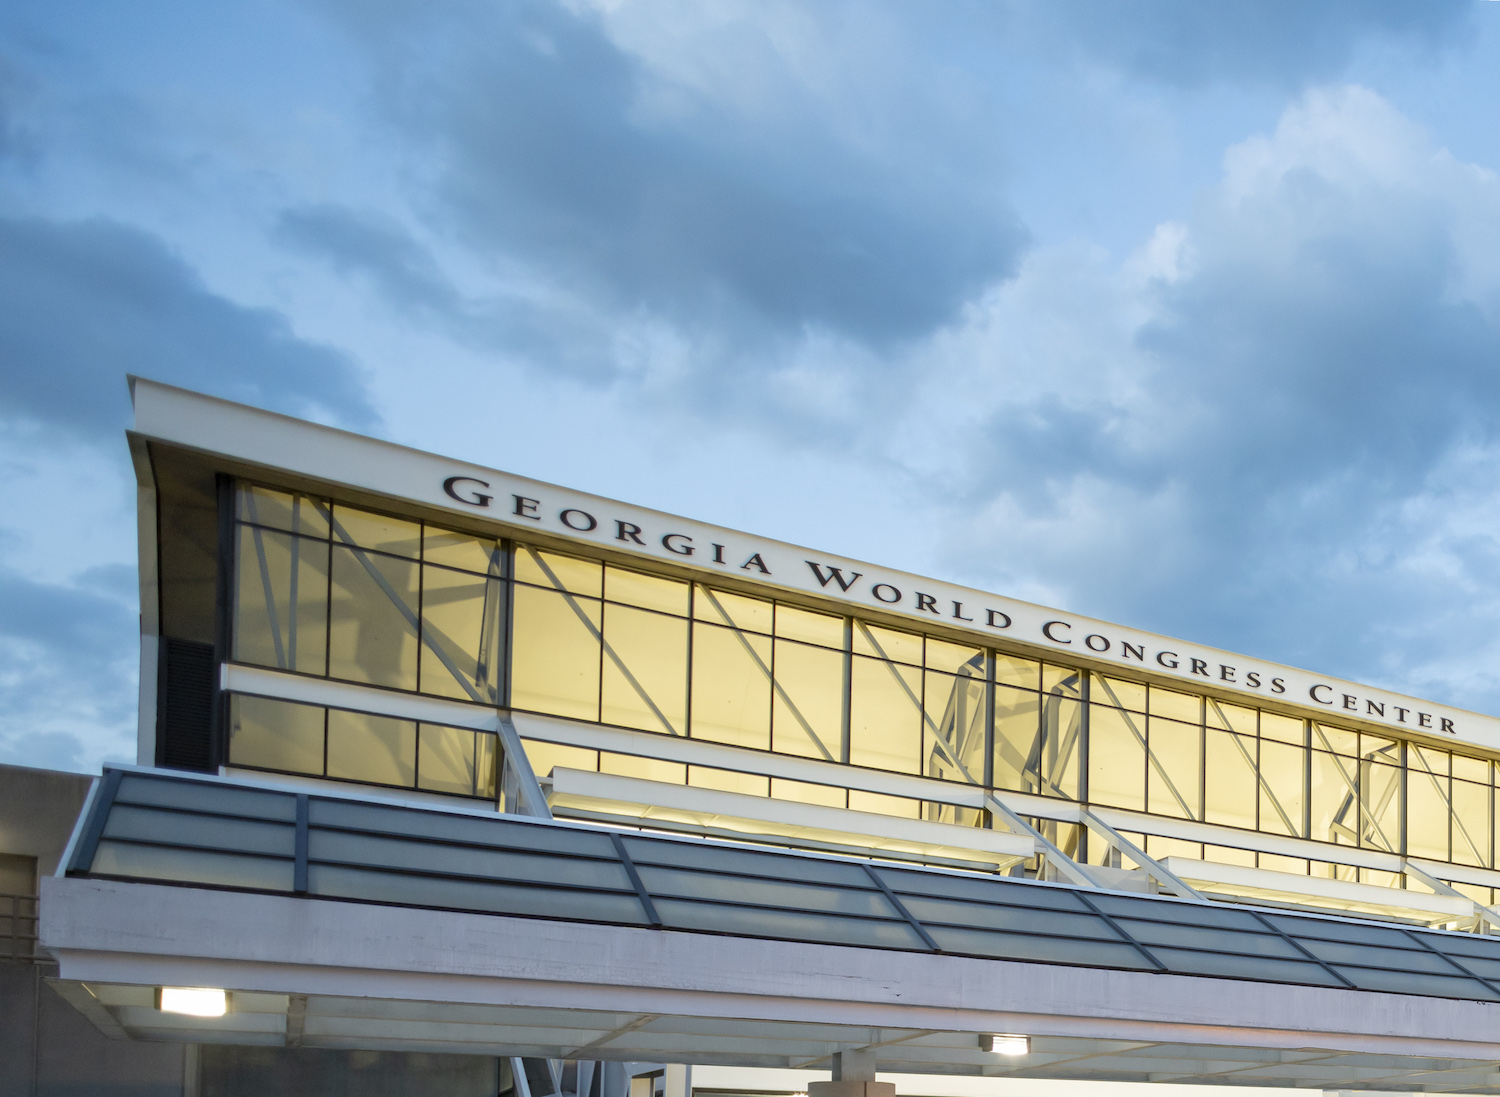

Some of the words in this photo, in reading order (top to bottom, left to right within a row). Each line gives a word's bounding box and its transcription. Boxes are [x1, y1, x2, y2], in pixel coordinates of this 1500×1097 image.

[443, 476, 772, 574] GEORGIA
[805, 560, 1012, 629] WORLD
[1042, 621, 1286, 694] CONGRESS
[1309, 684, 1457, 734] CENTER
